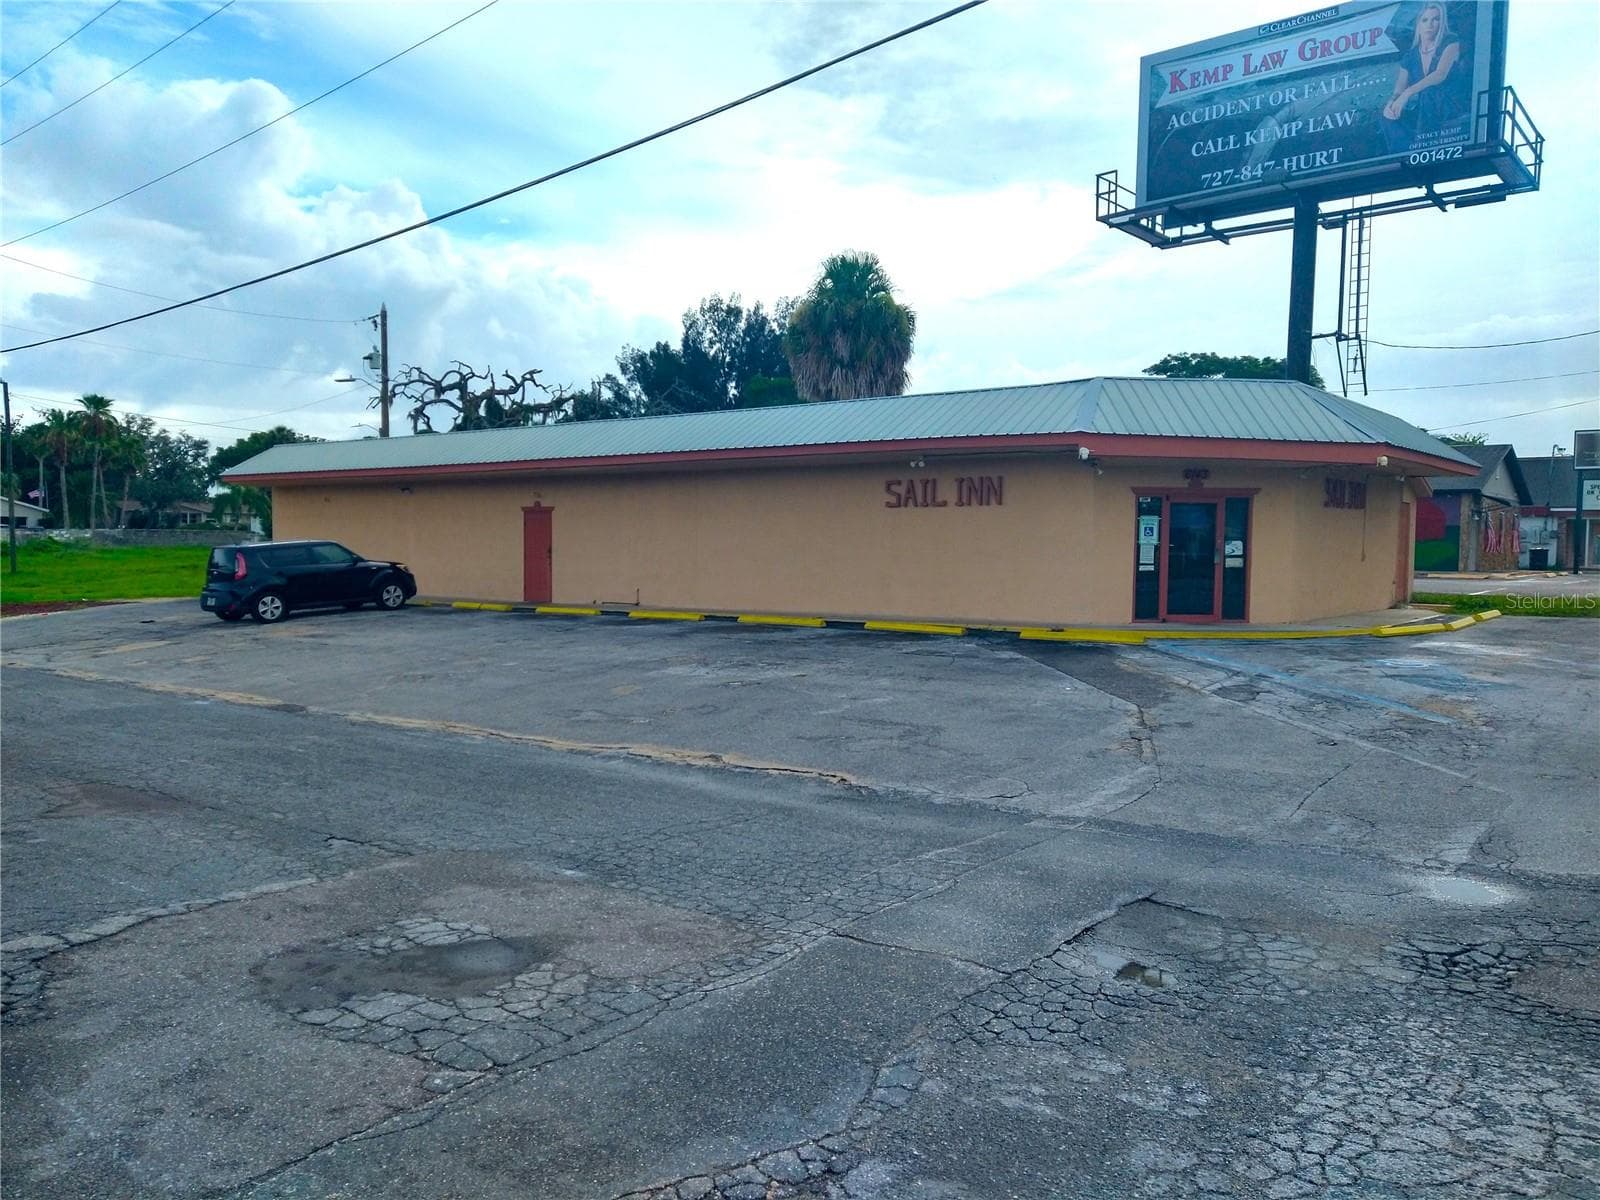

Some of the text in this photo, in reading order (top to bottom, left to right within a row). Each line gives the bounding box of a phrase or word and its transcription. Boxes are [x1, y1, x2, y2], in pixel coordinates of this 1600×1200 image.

[1169, 27, 1383, 94] KEMP LAW GROUP
[1167, 94, 1266, 130] ACCIDENT
[1269, 87, 1298, 106] OR
[1191, 109, 1357, 157] CALL KEMP LAW
[1201, 147, 1343, 189] 727-847-HURT
[1410, 146, 1463, 165] 001472
[885, 476, 1004, 508] SAIL INN
